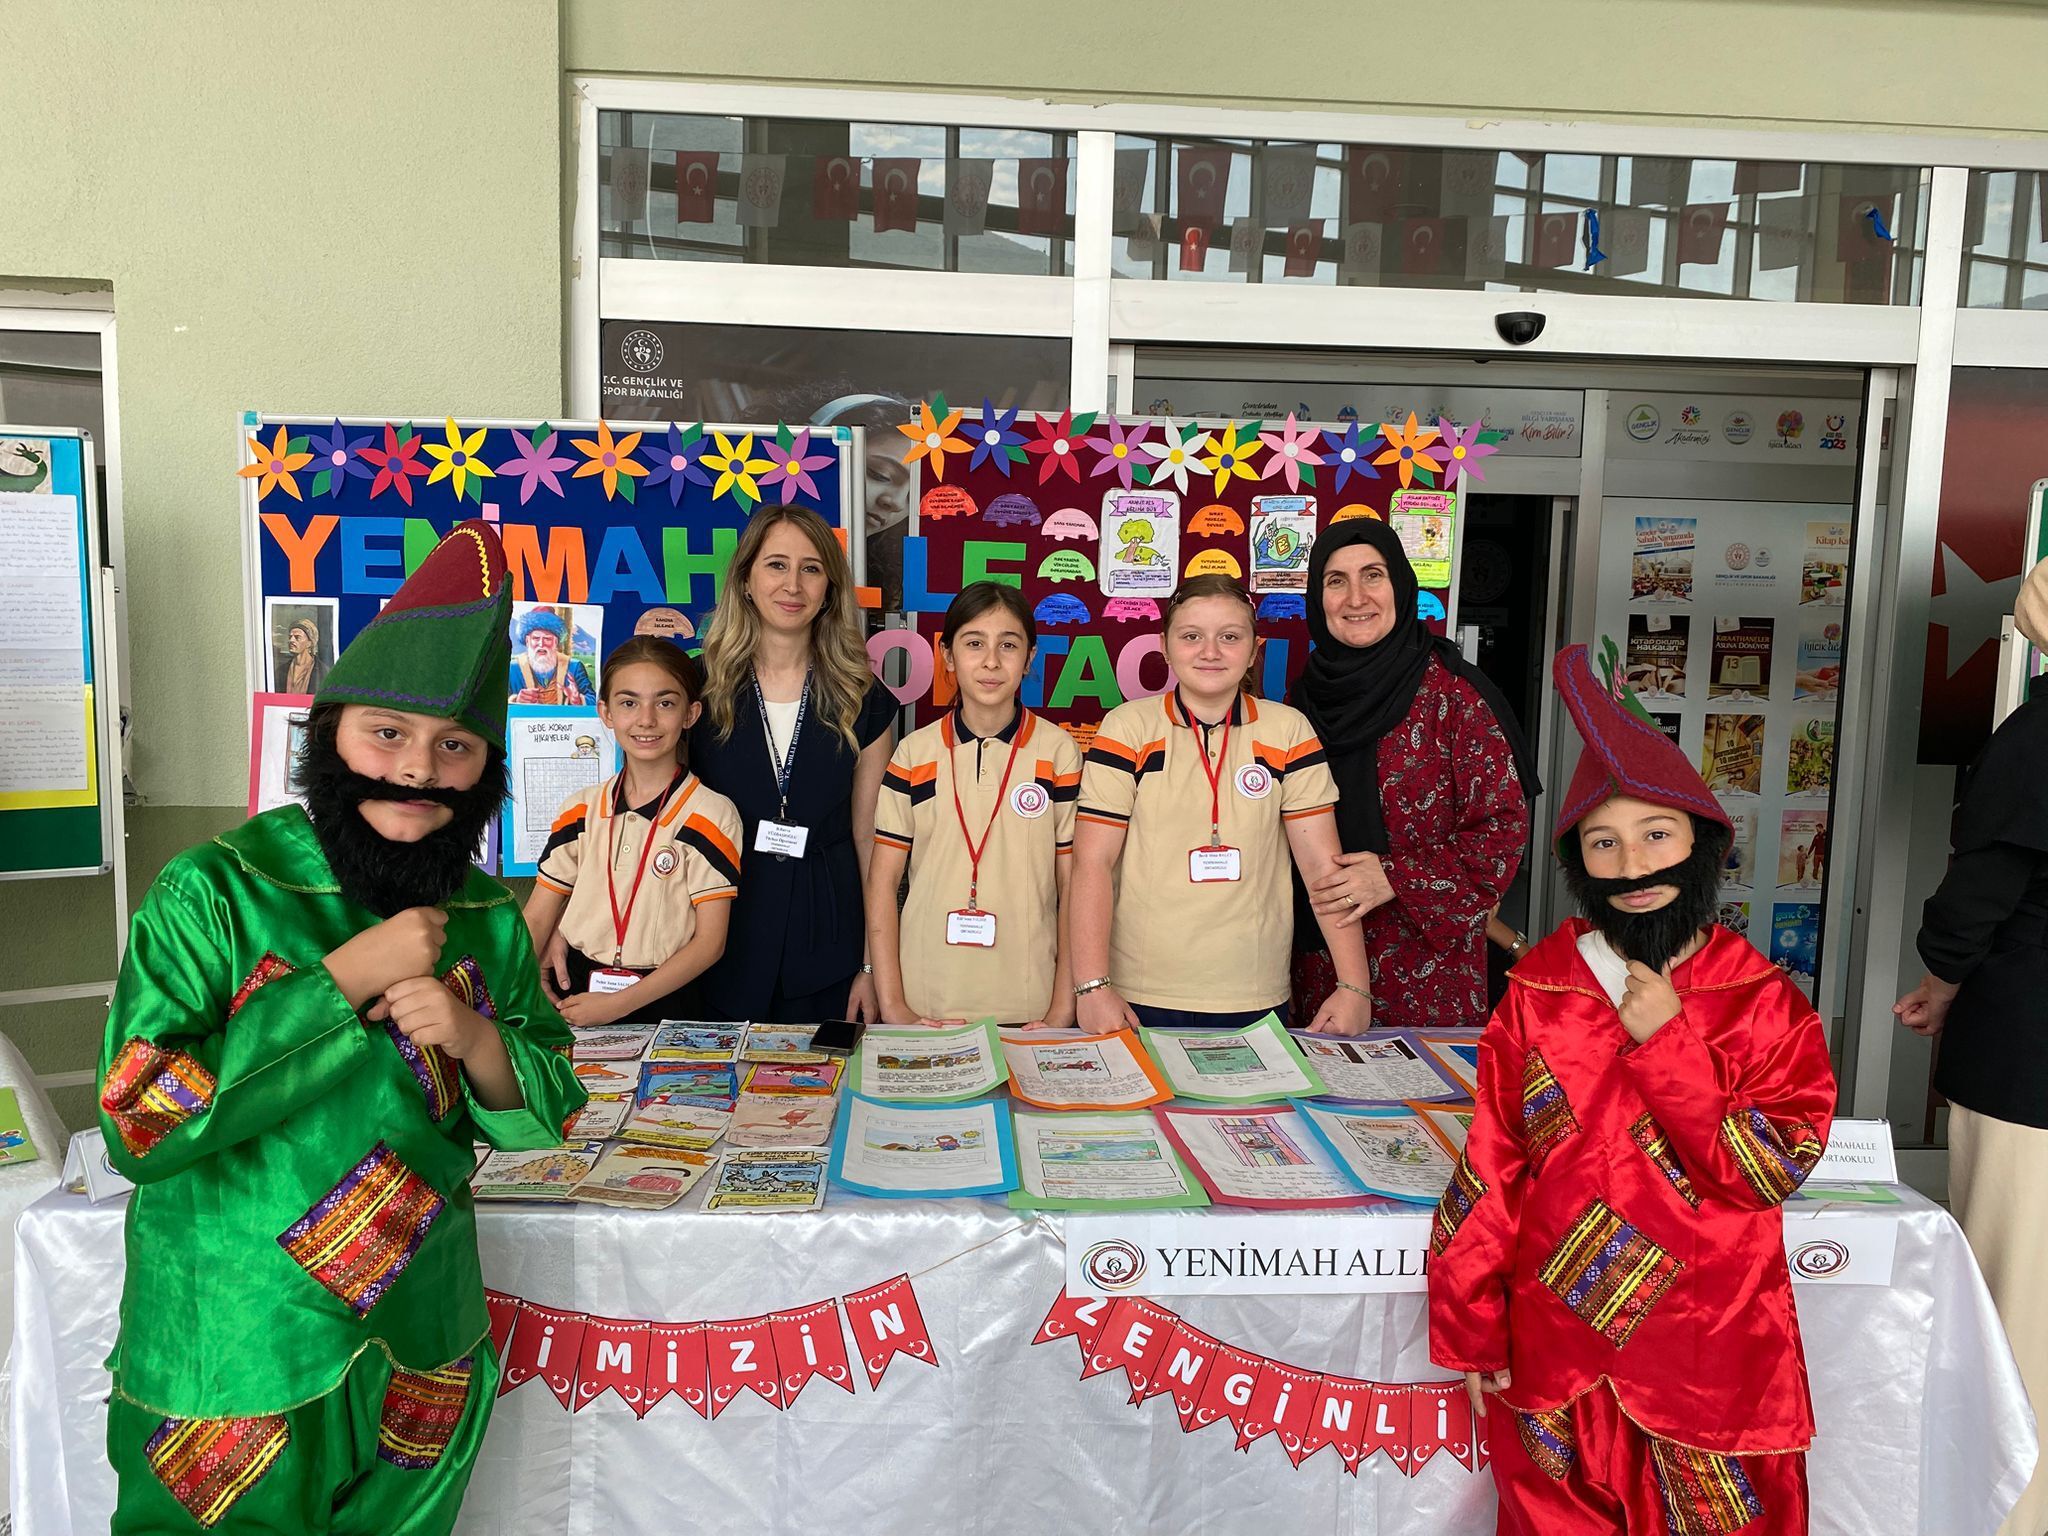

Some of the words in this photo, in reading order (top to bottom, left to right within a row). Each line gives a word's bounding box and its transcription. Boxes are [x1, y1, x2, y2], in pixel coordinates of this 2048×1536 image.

[603, 375, 620, 385] T.C.
[622, 376, 667, 388] GENÇLİK
[670, 378, 684, 388] VE
[603, 387, 628, 396] SPOR
[630, 388, 684, 399] BAKANLIĞI
[1819, 437, 1847, 450] 2023
[1726, 658, 1739, 670] 13
[548, 723, 574, 734] KORKUT
[1821, 1154, 1876, 1164] ORTAOKULU
